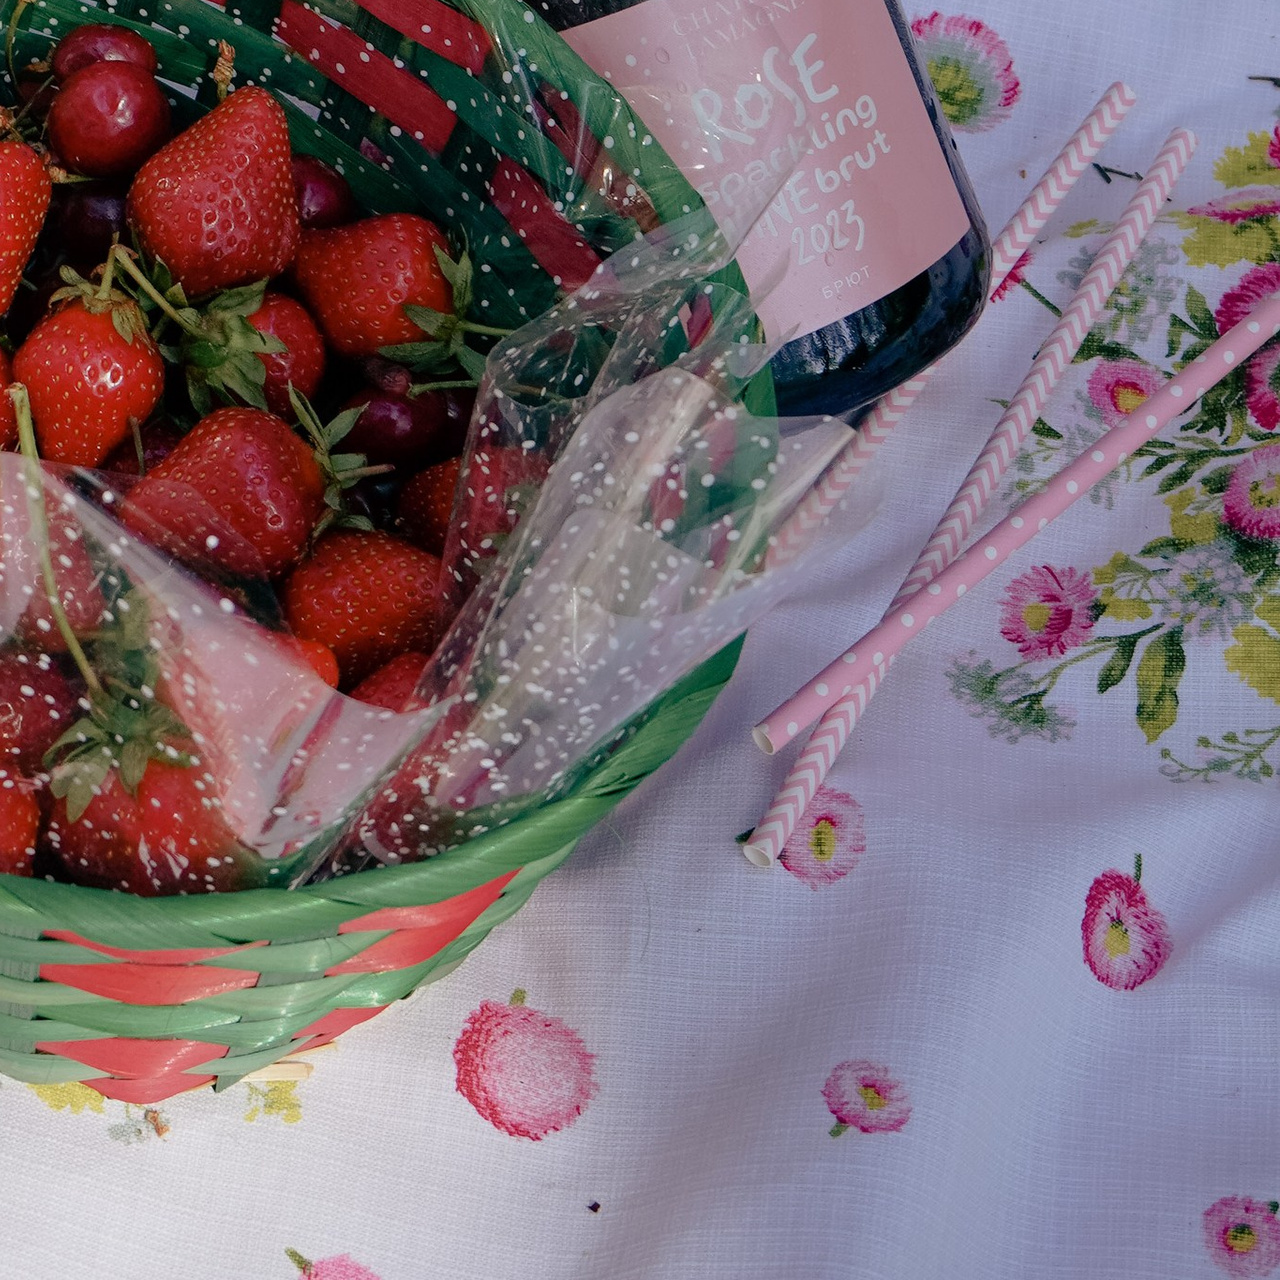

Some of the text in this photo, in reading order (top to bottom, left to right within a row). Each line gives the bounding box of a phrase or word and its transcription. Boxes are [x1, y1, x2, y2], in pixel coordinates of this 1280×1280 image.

[691, 33, 840, 165] ROSE
[696, 94, 878, 207] sparkling
[815, 128, 891, 194] brut
[790, 198, 866, 267] 2023
[822, 265, 871, 300] БРЮТ
